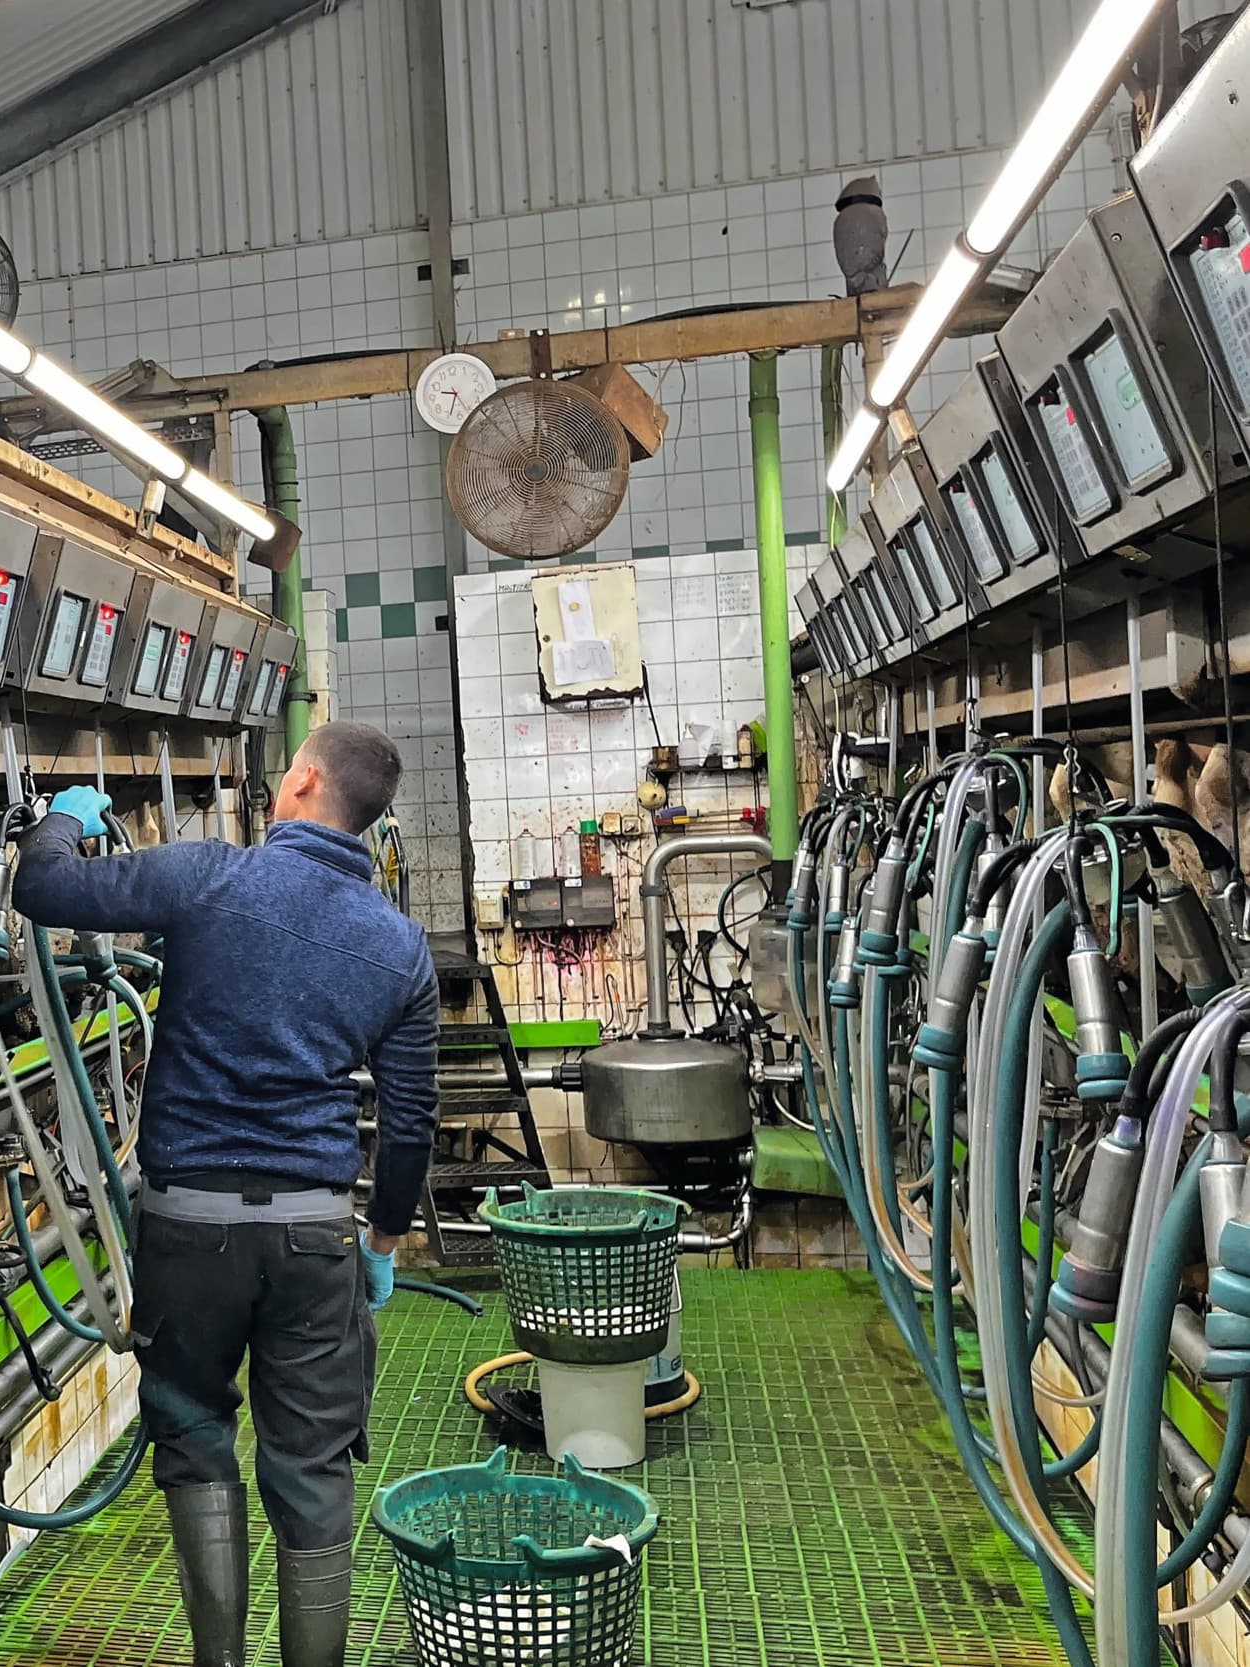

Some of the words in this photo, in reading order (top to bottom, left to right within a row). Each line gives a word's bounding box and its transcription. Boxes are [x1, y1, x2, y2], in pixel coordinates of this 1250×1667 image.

[439, 371, 446, 381] 11
[448, 366, 457, 376] 12
[472, 372, 479, 383] 2
[431, 381, 441, 392] 10
[429, 394, 436, 404] 9
[434, 403, 442, 414] 8
[457, 411, 464, 420] 6
